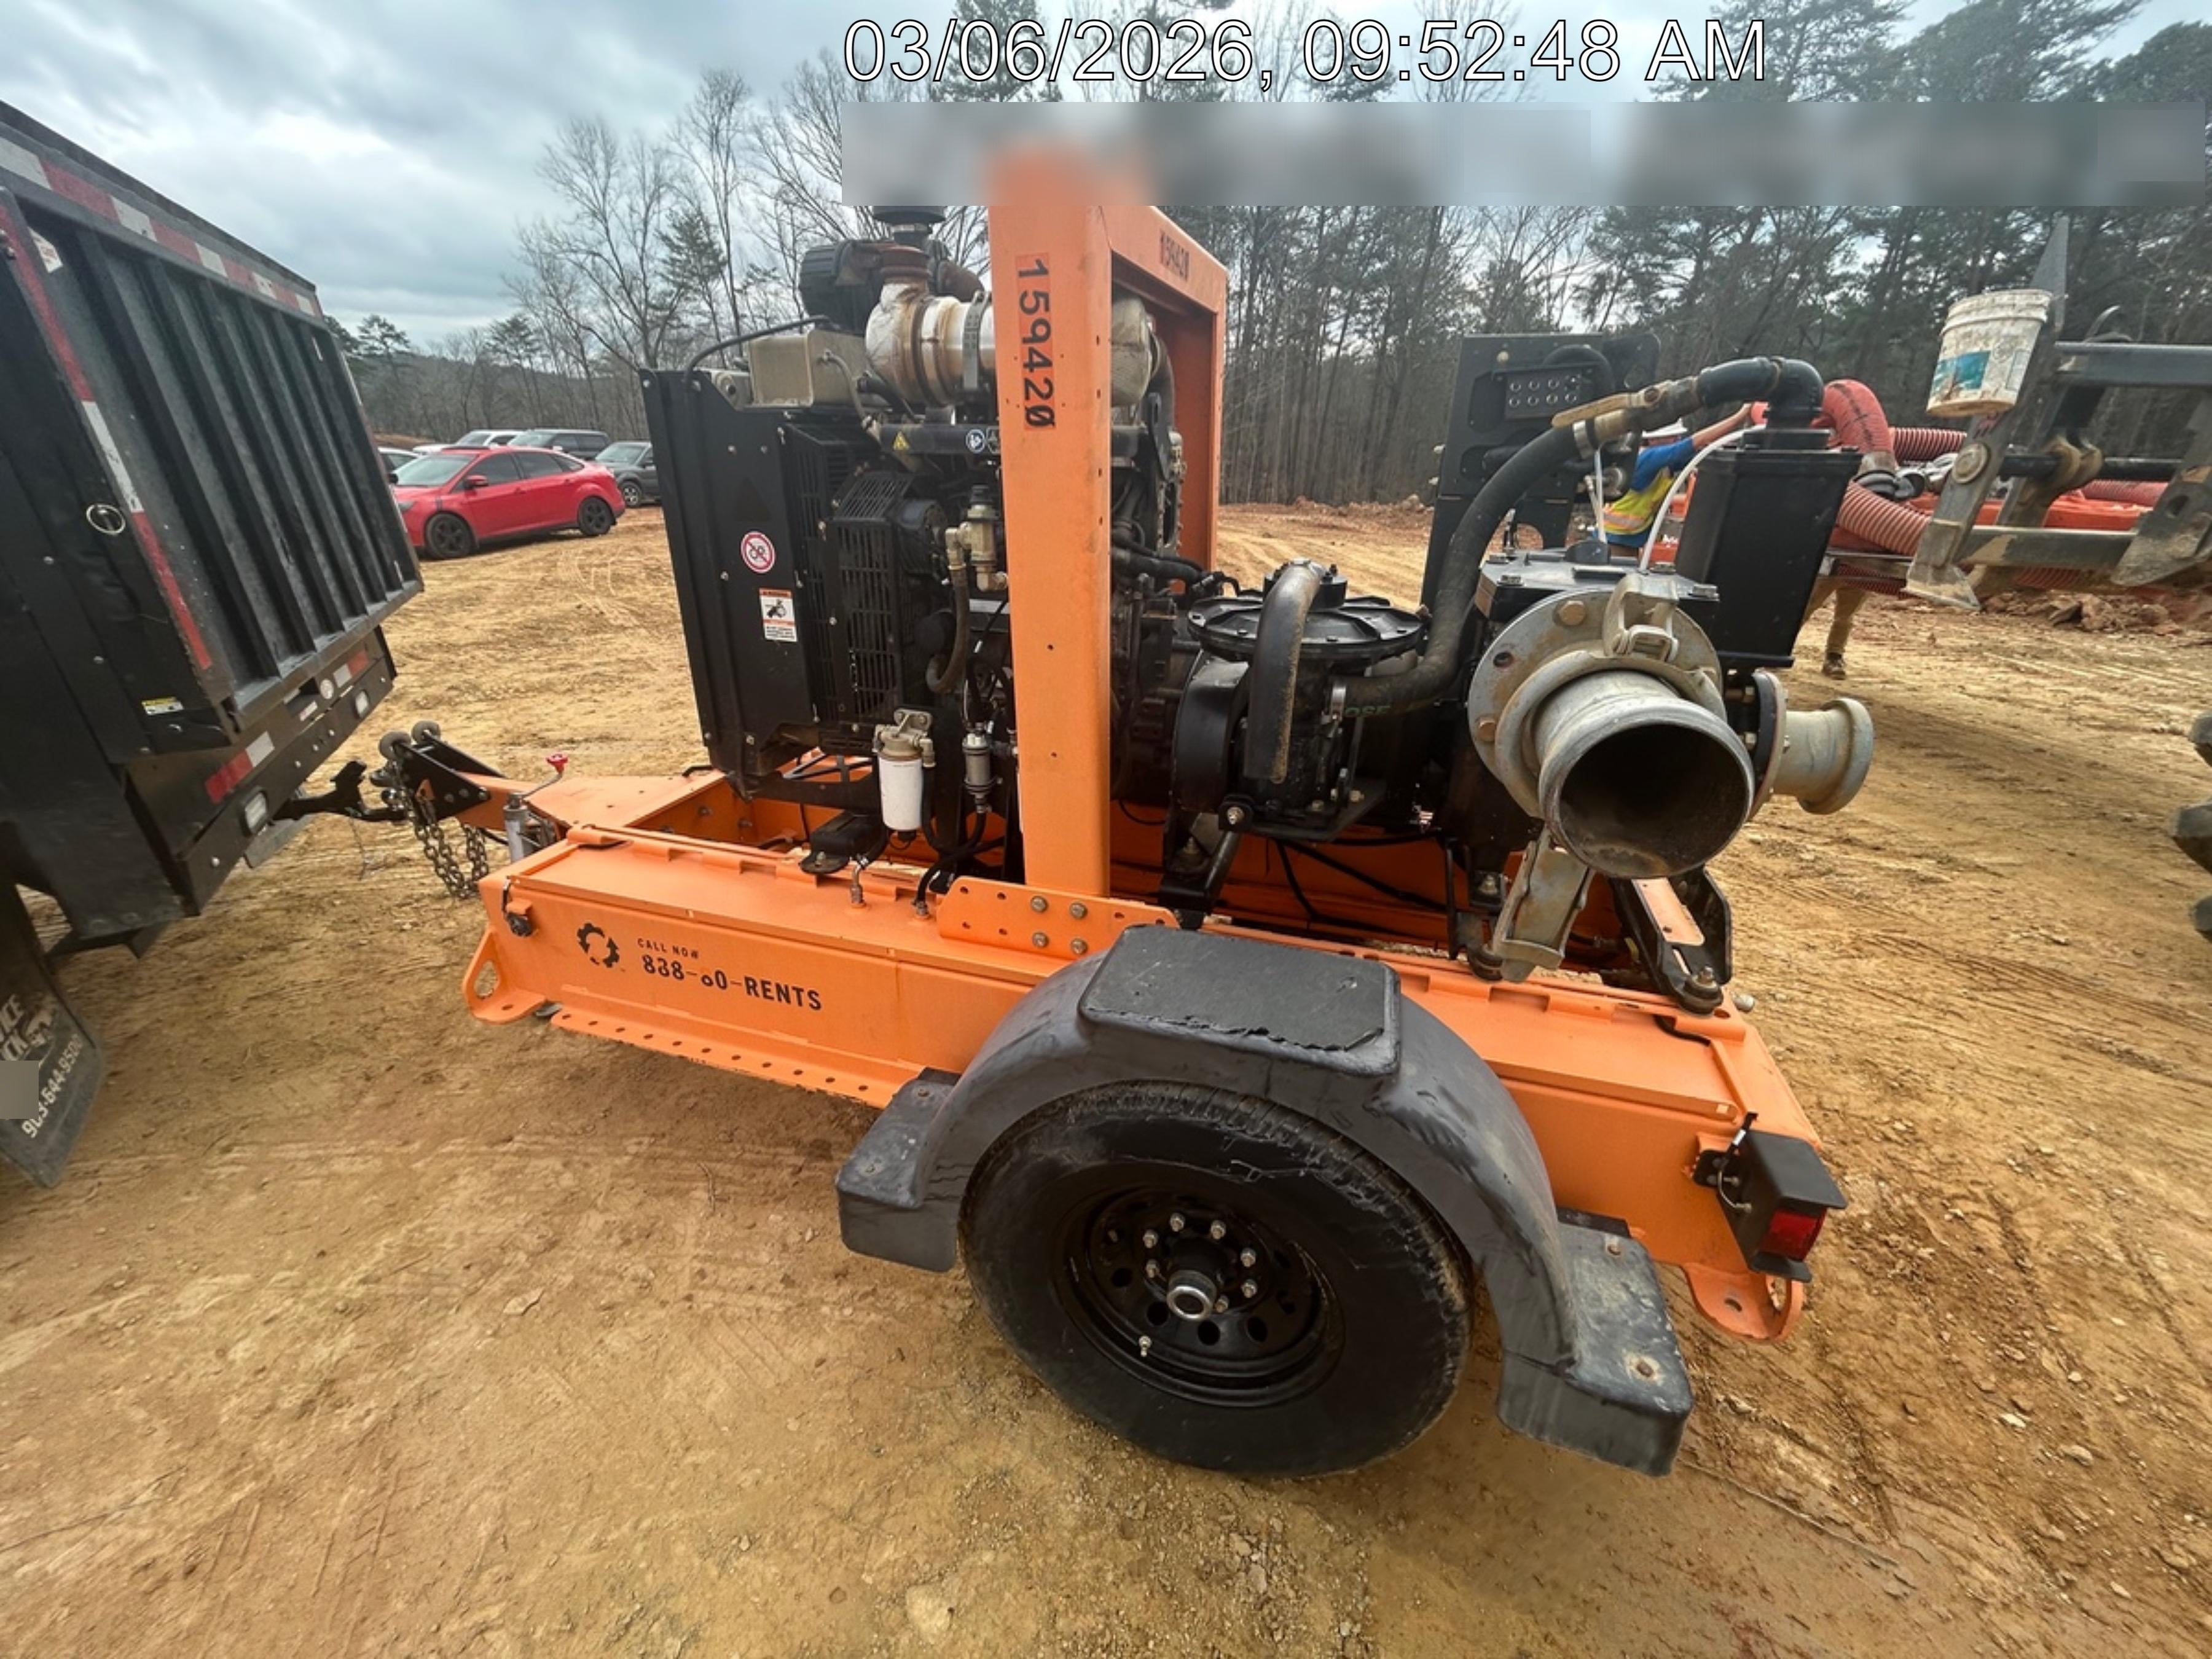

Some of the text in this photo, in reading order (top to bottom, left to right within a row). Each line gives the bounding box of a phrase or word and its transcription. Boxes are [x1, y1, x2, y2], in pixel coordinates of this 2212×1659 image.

[1018, 258, 1056, 428] 159420
[637, 938, 699, 959] CALL NOW
